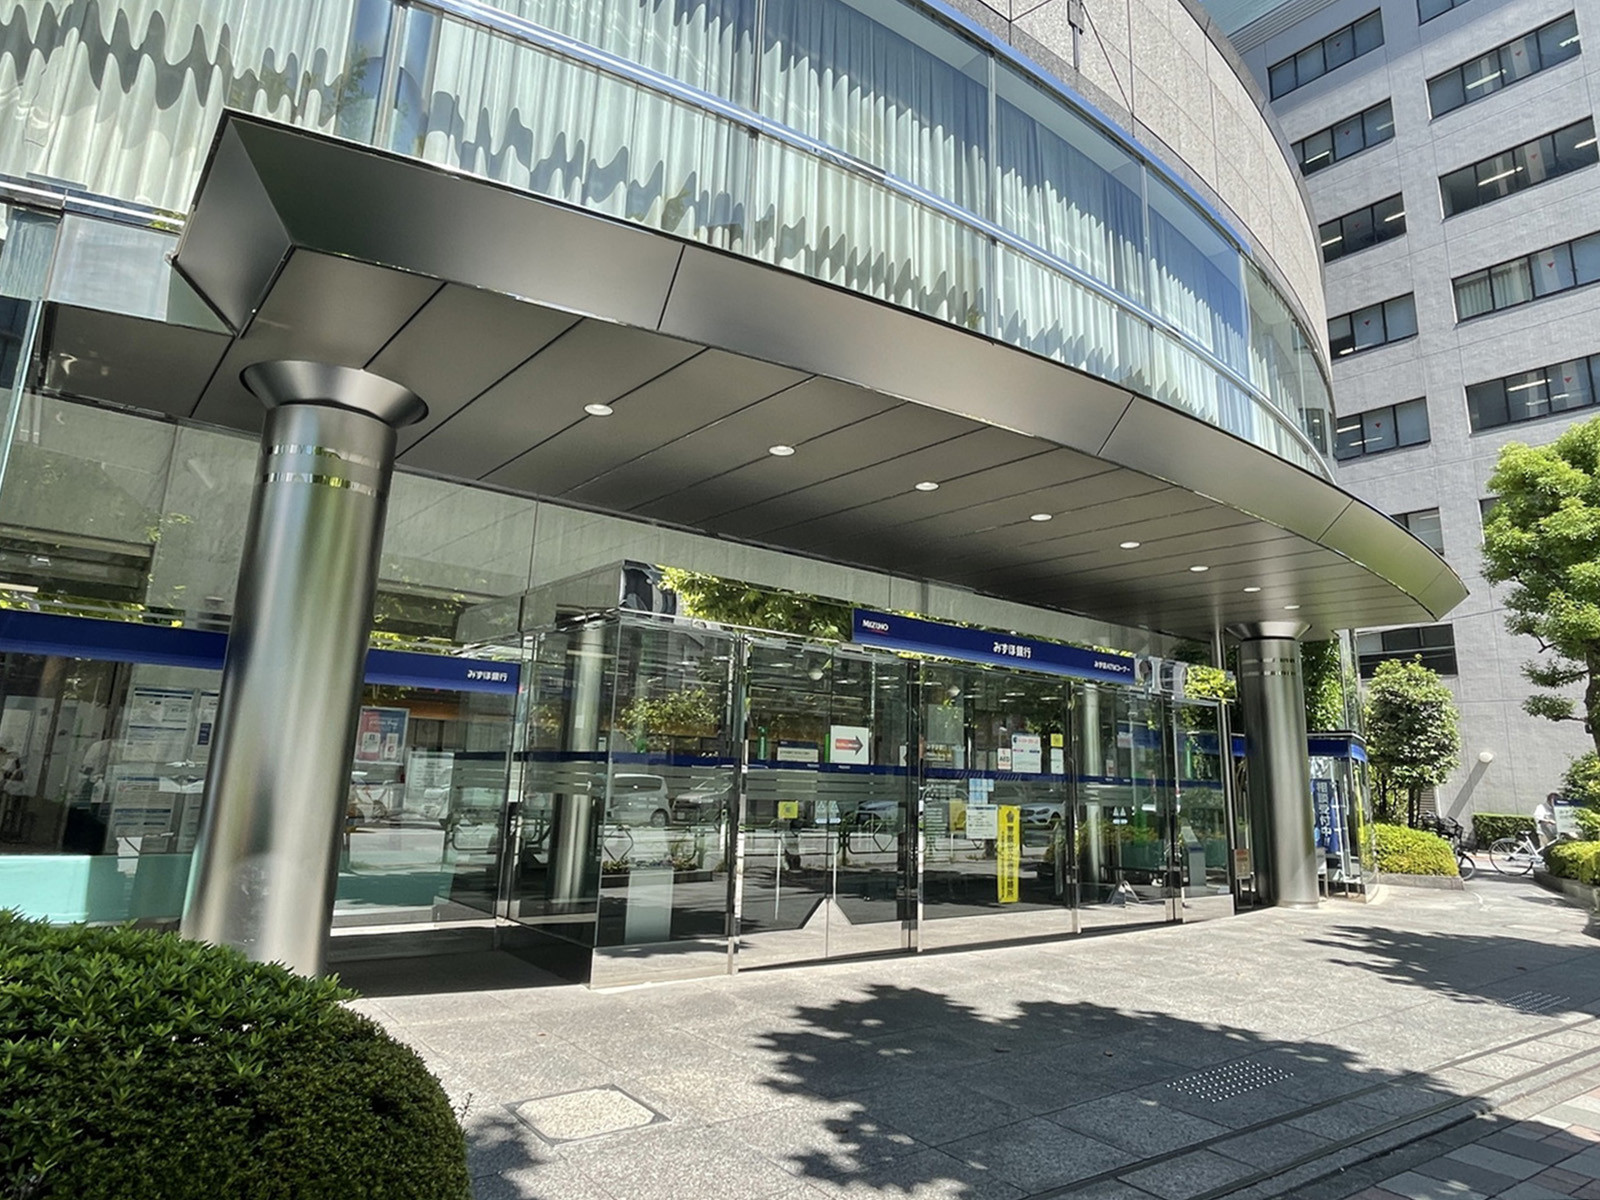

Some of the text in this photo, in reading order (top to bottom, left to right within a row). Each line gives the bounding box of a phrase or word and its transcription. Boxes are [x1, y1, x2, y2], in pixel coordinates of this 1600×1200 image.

[862, 619, 889, 632] MIZUHO
[993, 641, 1031, 659] みずほ銀行
[467, 669, 508, 682] みずほ銀行
